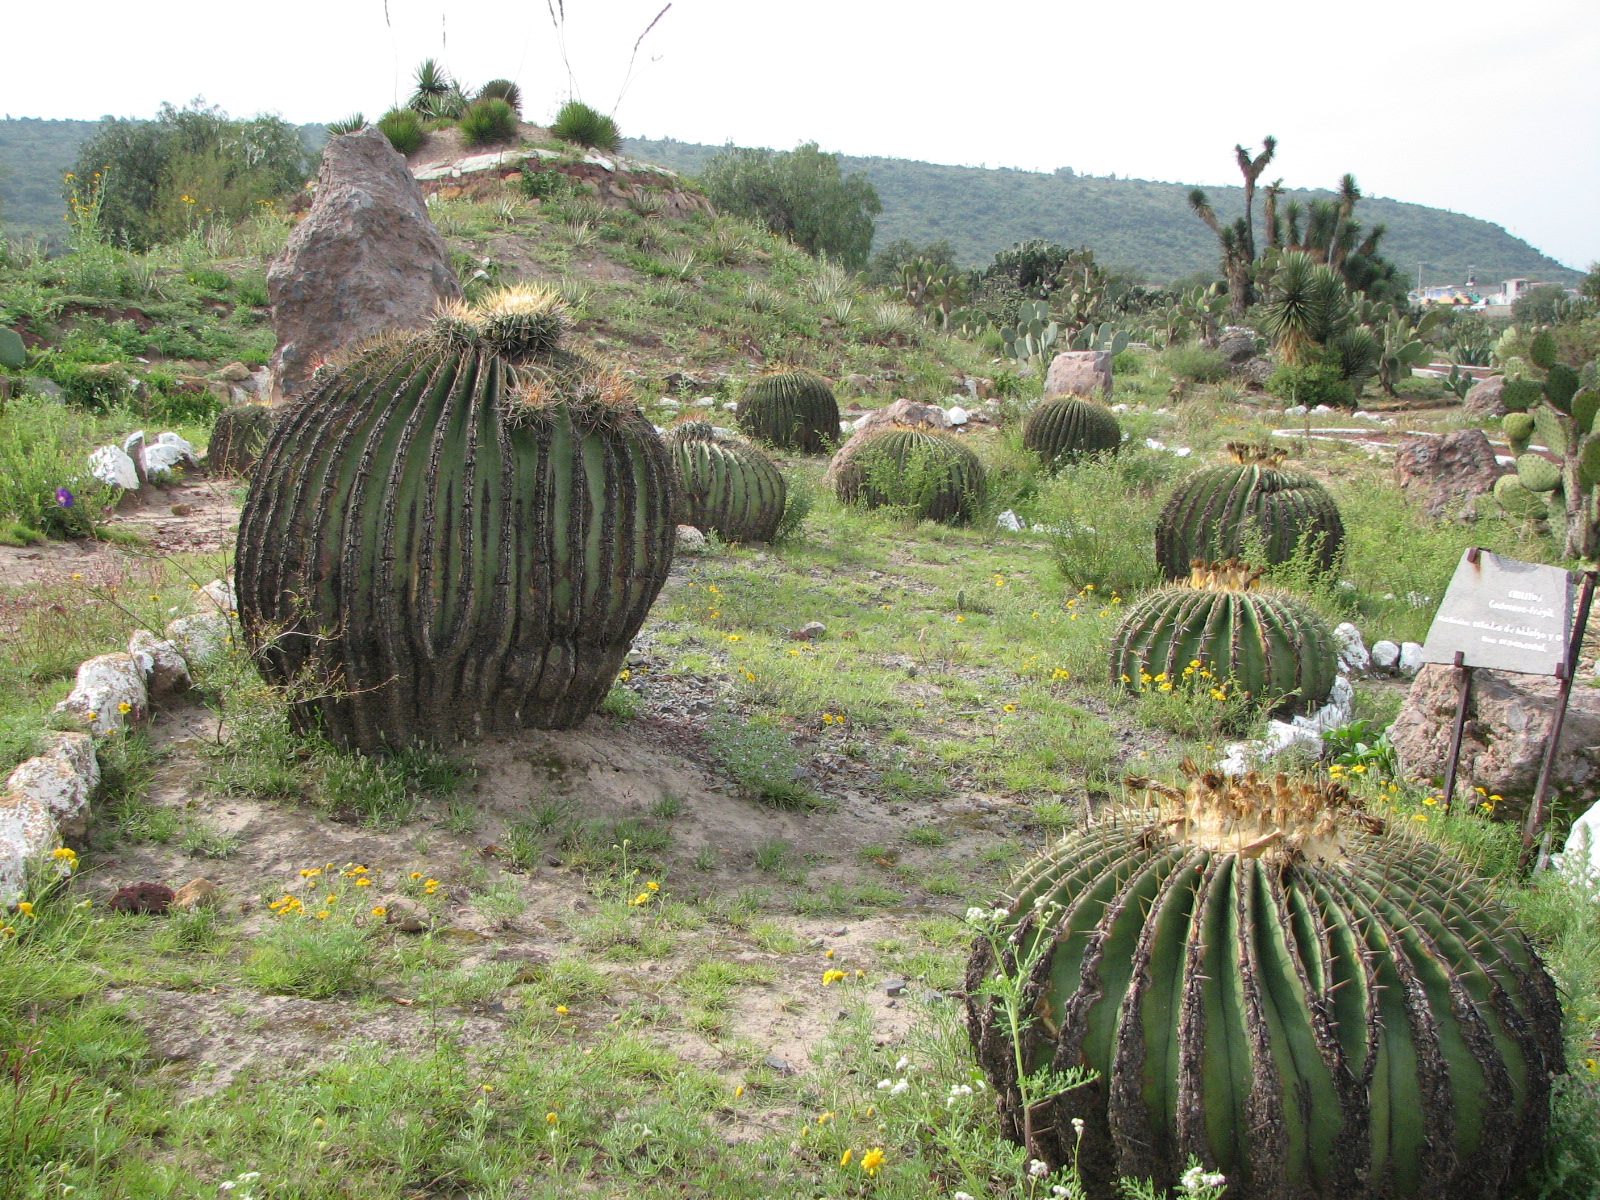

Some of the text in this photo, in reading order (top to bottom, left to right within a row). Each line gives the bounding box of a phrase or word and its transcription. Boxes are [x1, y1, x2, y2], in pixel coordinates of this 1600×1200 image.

[1472, 621, 1502, 632] estados
[1503, 624, 1514, 634] de
[1548, 633, 1554, 641] y
